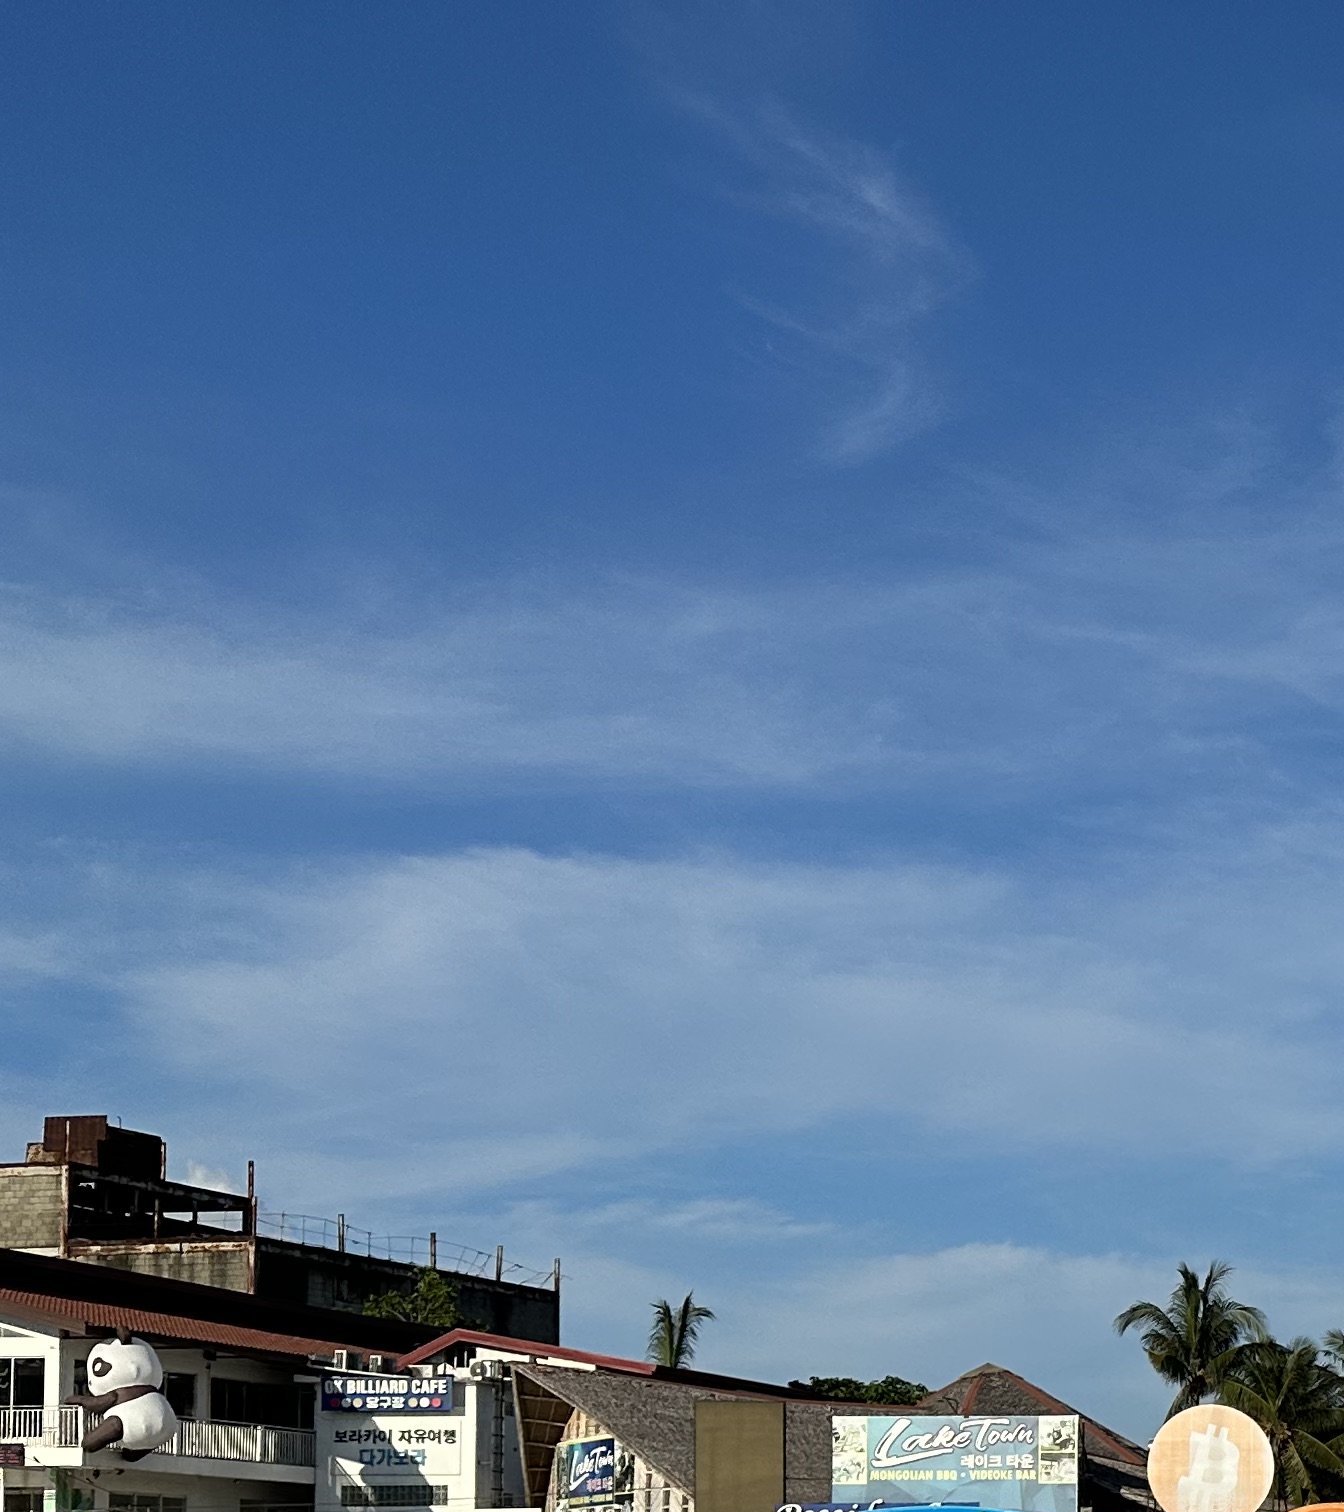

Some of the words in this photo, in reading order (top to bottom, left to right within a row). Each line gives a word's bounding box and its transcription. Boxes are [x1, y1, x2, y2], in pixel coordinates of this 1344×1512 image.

[324, 1379, 343, 1394] OK
[346, 1379, 408, 1394] BILLIARD
[411, 1379, 447, 1394] CAFE
[333, 1429, 393, 1445] 보라카이
[398, 1429, 457, 1445] 자유여행
[870, 1417, 972, 1469] Lake
[959, 1417, 1034, 1452] Town
[358, 1448, 428, 1467] 다가보라
[960, 1454, 1003, 1469] 레이크
[1005, 1454, 1035, 1469] 타운
[569, 1450, 594, 1491] Lake
[869, 1469, 934, 1481] MONGOLIAN
[936, 1469, 958, 1481] BBQ
[969, 1469, 1013, 1480] VIDEOKE
[1015, 1469, 1037, 1480] BAR
